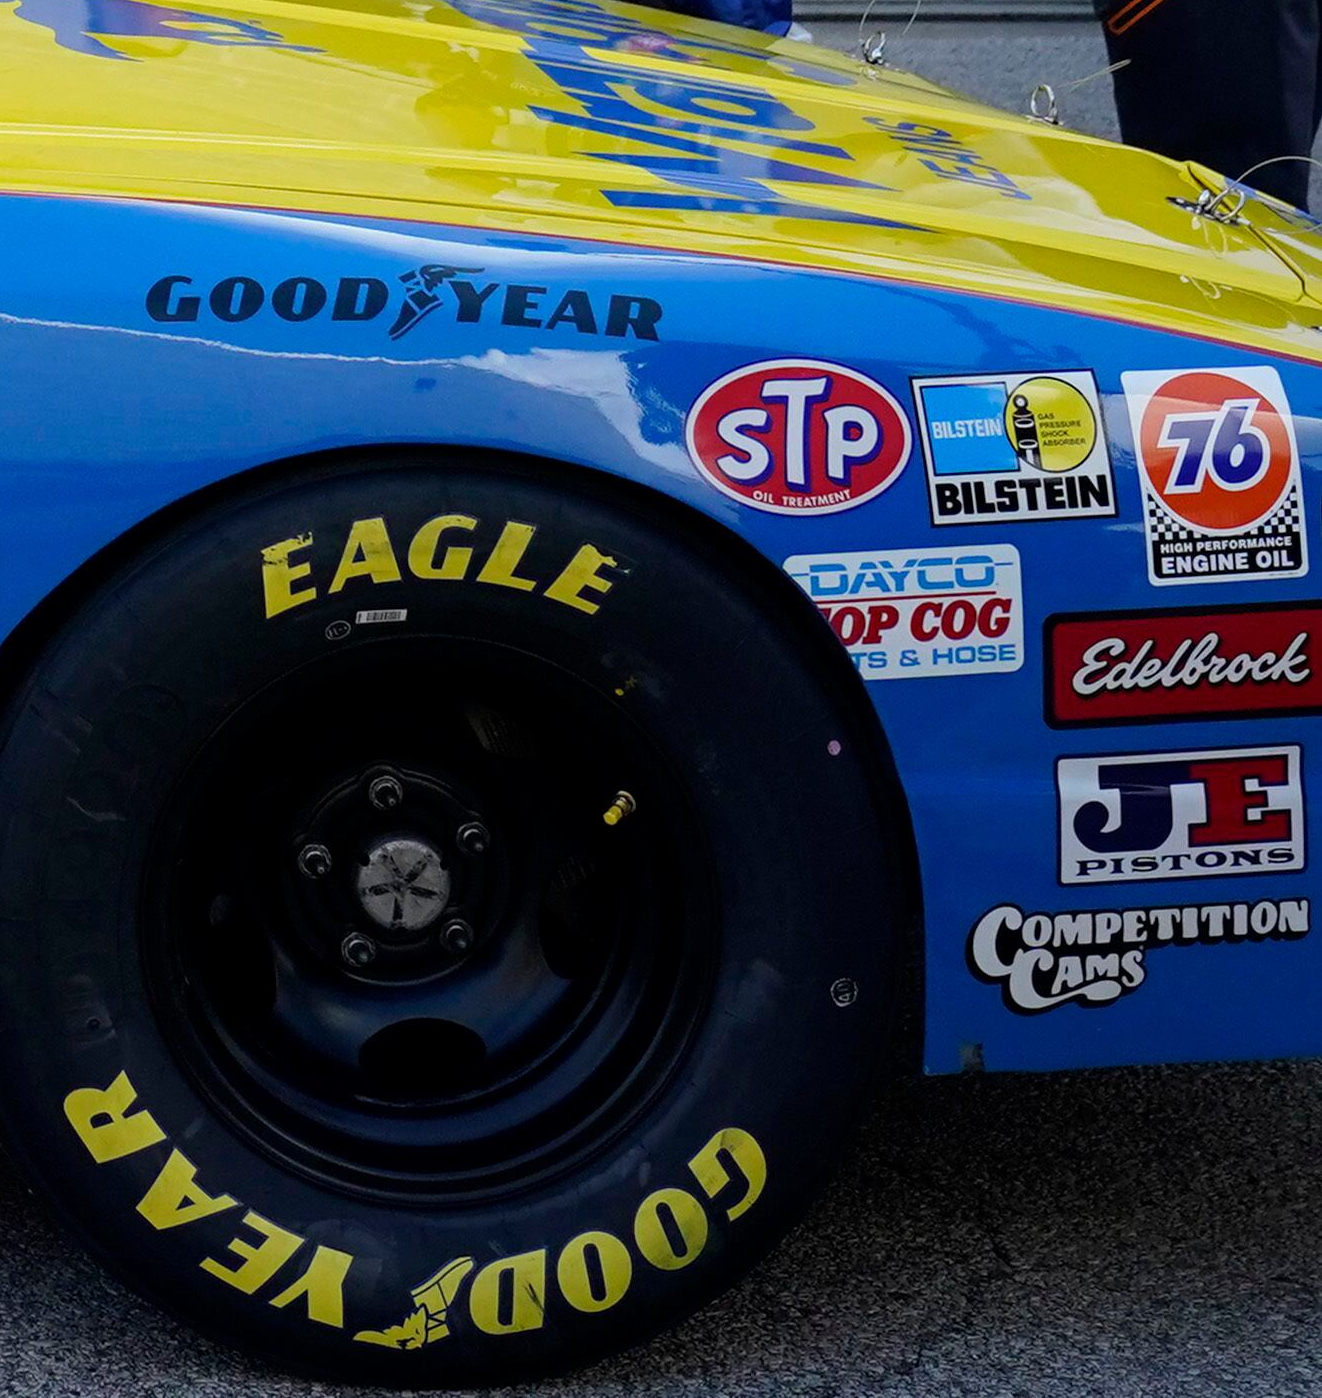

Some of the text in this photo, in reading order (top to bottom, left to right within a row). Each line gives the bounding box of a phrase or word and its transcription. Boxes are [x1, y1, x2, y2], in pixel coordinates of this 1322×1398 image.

[862, 115, 1033, 200] JEANS
[716, 377, 879, 486] STP
[931, 417, 1003, 440] BILSTEIN
[1038, 419, 1082, 429] PRESSURE
[1041, 430, 1069, 438] SHOCK
[1042, 438, 1086, 447] ABSORBER
[1158, 396, 1272, 495] 76
[752, 489, 851, 507] OIL TREATMENT
[935, 474, 1110, 517] BILSTEIN
[260, 513, 633, 620] EAGLE
[1160, 536, 1293, 554] HIGH PERFORMANCE
[1161, 549, 1294, 575] ENGINE OIL
[808, 554, 995, 597] DAYCO
[910, 597, 1012, 642] COG
[932, 644, 1016, 665] HOSE
[1072, 632, 1311, 695] Edelbrock
[1072, 754, 1293, 855] JE
[1074, 847, 1295, 877] PISTONS
[972, 900, 1310, 978] COMPETITION
[1009, 947, 1146, 1011] CAMS
